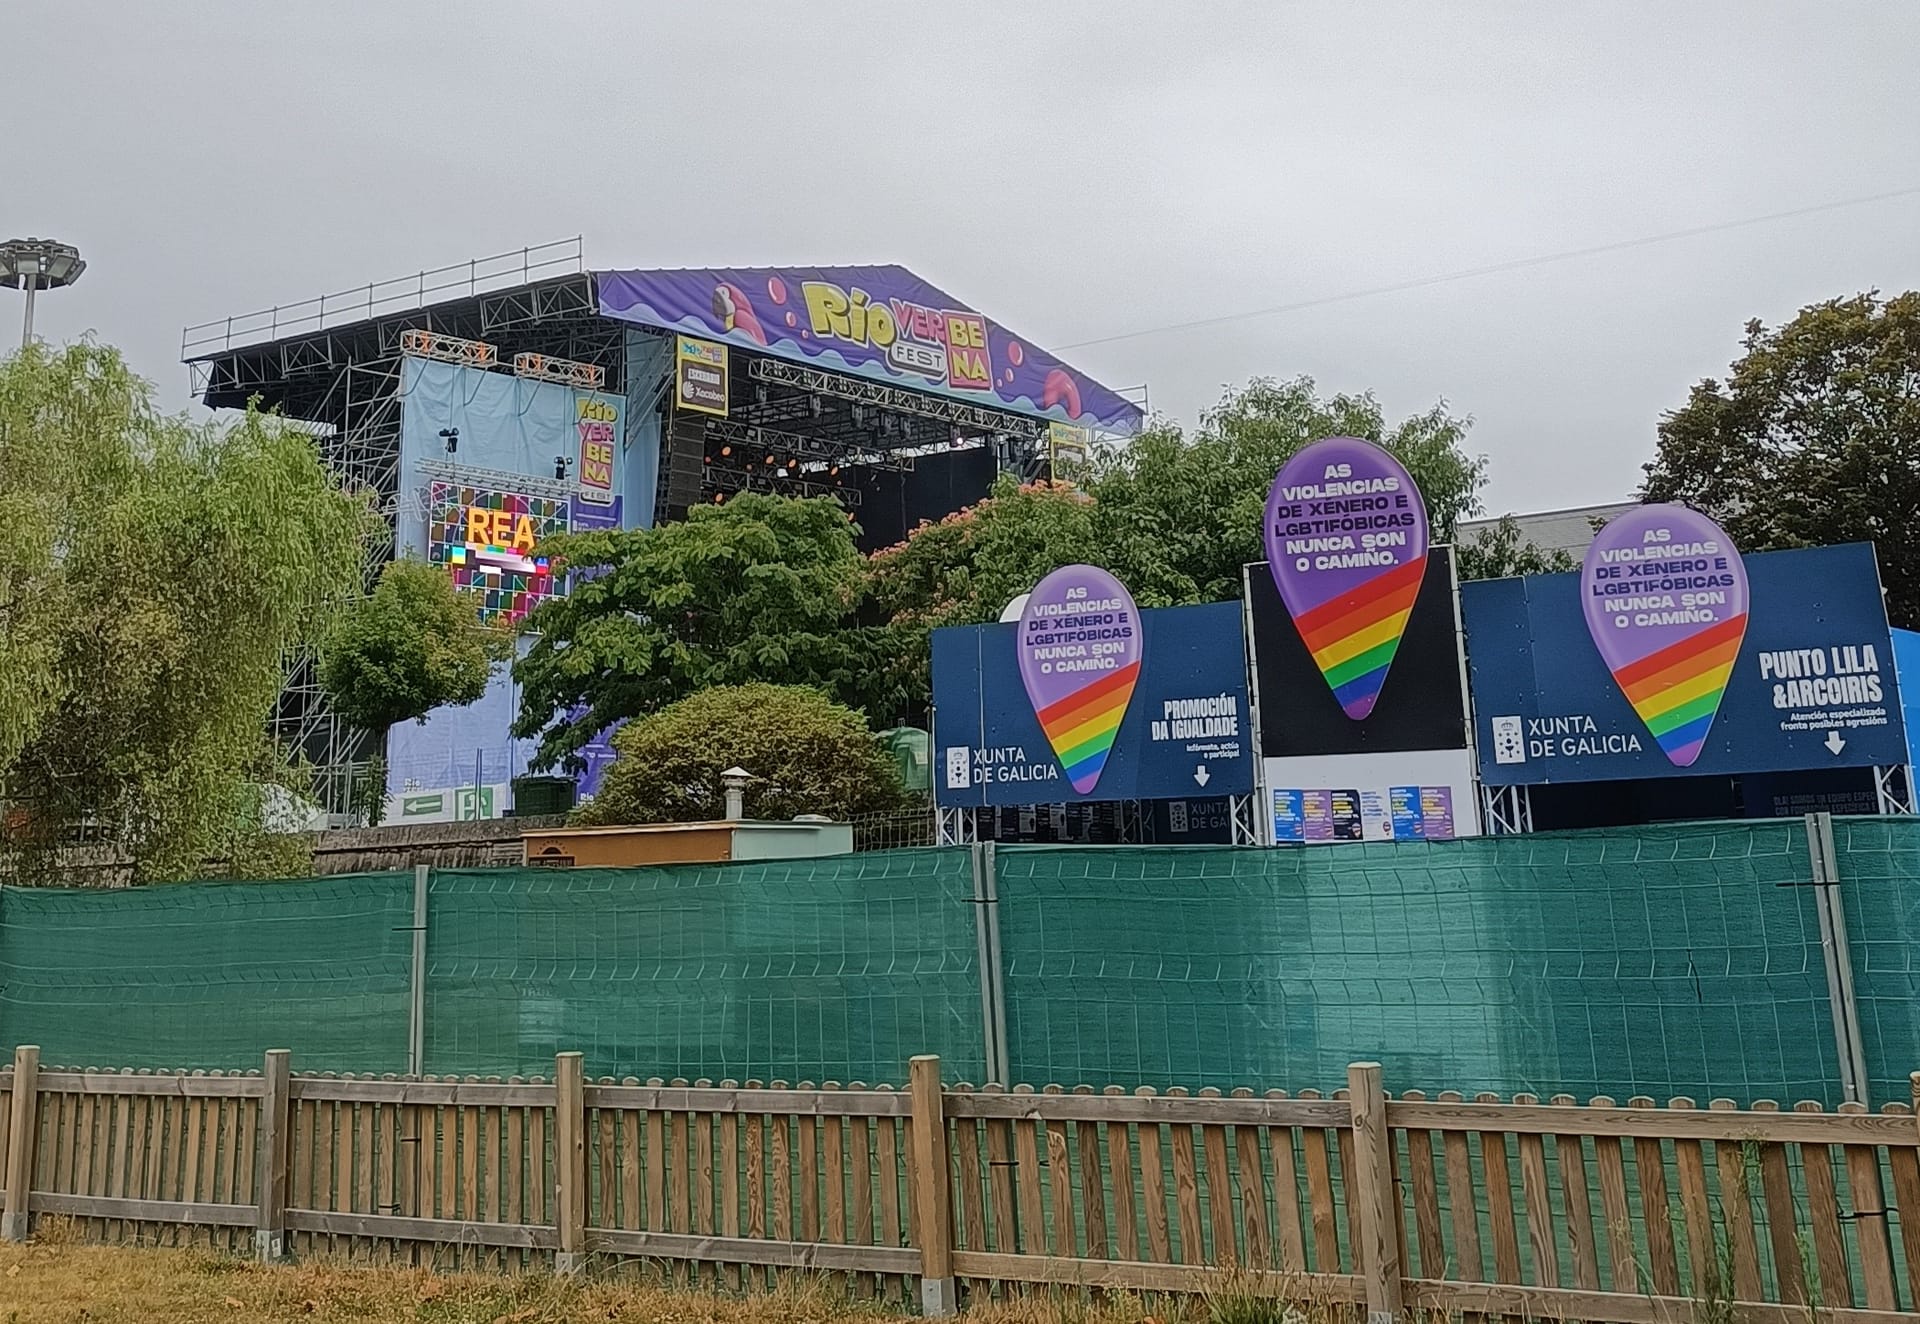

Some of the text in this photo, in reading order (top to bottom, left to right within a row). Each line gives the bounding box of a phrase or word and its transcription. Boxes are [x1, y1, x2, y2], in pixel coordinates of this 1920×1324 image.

[896, 346, 942, 368] FEST
[695, 387, 725, 402] Xacobeo
[1324, 464, 1352, 479] AS
[1282, 477, 1399, 501] VIOLENCIAS
[1278, 495, 1408, 519] DE XÉNERO E
[468, 508, 535, 549] REA
[1275, 513, 1415, 537] LGBTIFÓBICAS
[1643, 529, 1671, 543] AS
[1286, 531, 1406, 554] NUNCA SON
[1600, 541, 1719, 563] VIOLENCIAS
[1296, 549, 1398, 572] O CAMIÑO.
[1596, 557, 1728, 579] DE XÉNERO E
[1066, 587, 1087, 599] AS
[1592, 574, 1735, 596] LGBTIFÓBICAS
[1033, 599, 1122, 617] VIOLENCIAS
[1605, 591, 1725, 612] NUNCA SON
[1029, 612, 1128, 631] DE XÉNERO E
[1615, 606, 1719, 628] O CAMIÑO.
[1026, 627, 1132, 646] LGBTIFÓBICAS
[1034, 642, 1125, 660] NUNCA SON
[1759, 644, 1879, 680] PUNTO LILA
[1041, 655, 1119, 674] O CAMIÑO.
[1773, 674, 1883, 709] &ARCOIRIS
[1164, 692, 1237, 720] PROMOCIÓN
[1790, 706, 1886, 721] Atención especializada
[1152, 716, 1239, 741] DA IGUALDADE
[1528, 715, 1597, 737] XUNTA
[1809, 719, 1844, 731] posibles
[1846, 715, 1888, 730] agresións
[973, 747, 1026, 765] XUNTA
[1530, 734, 1642, 758] DE GALICIA
[974, 764, 1058, 784] DE GALICIA
[1191, 801, 1229, 815] XUNTA
[1192, 817, 1207, 829] DE
